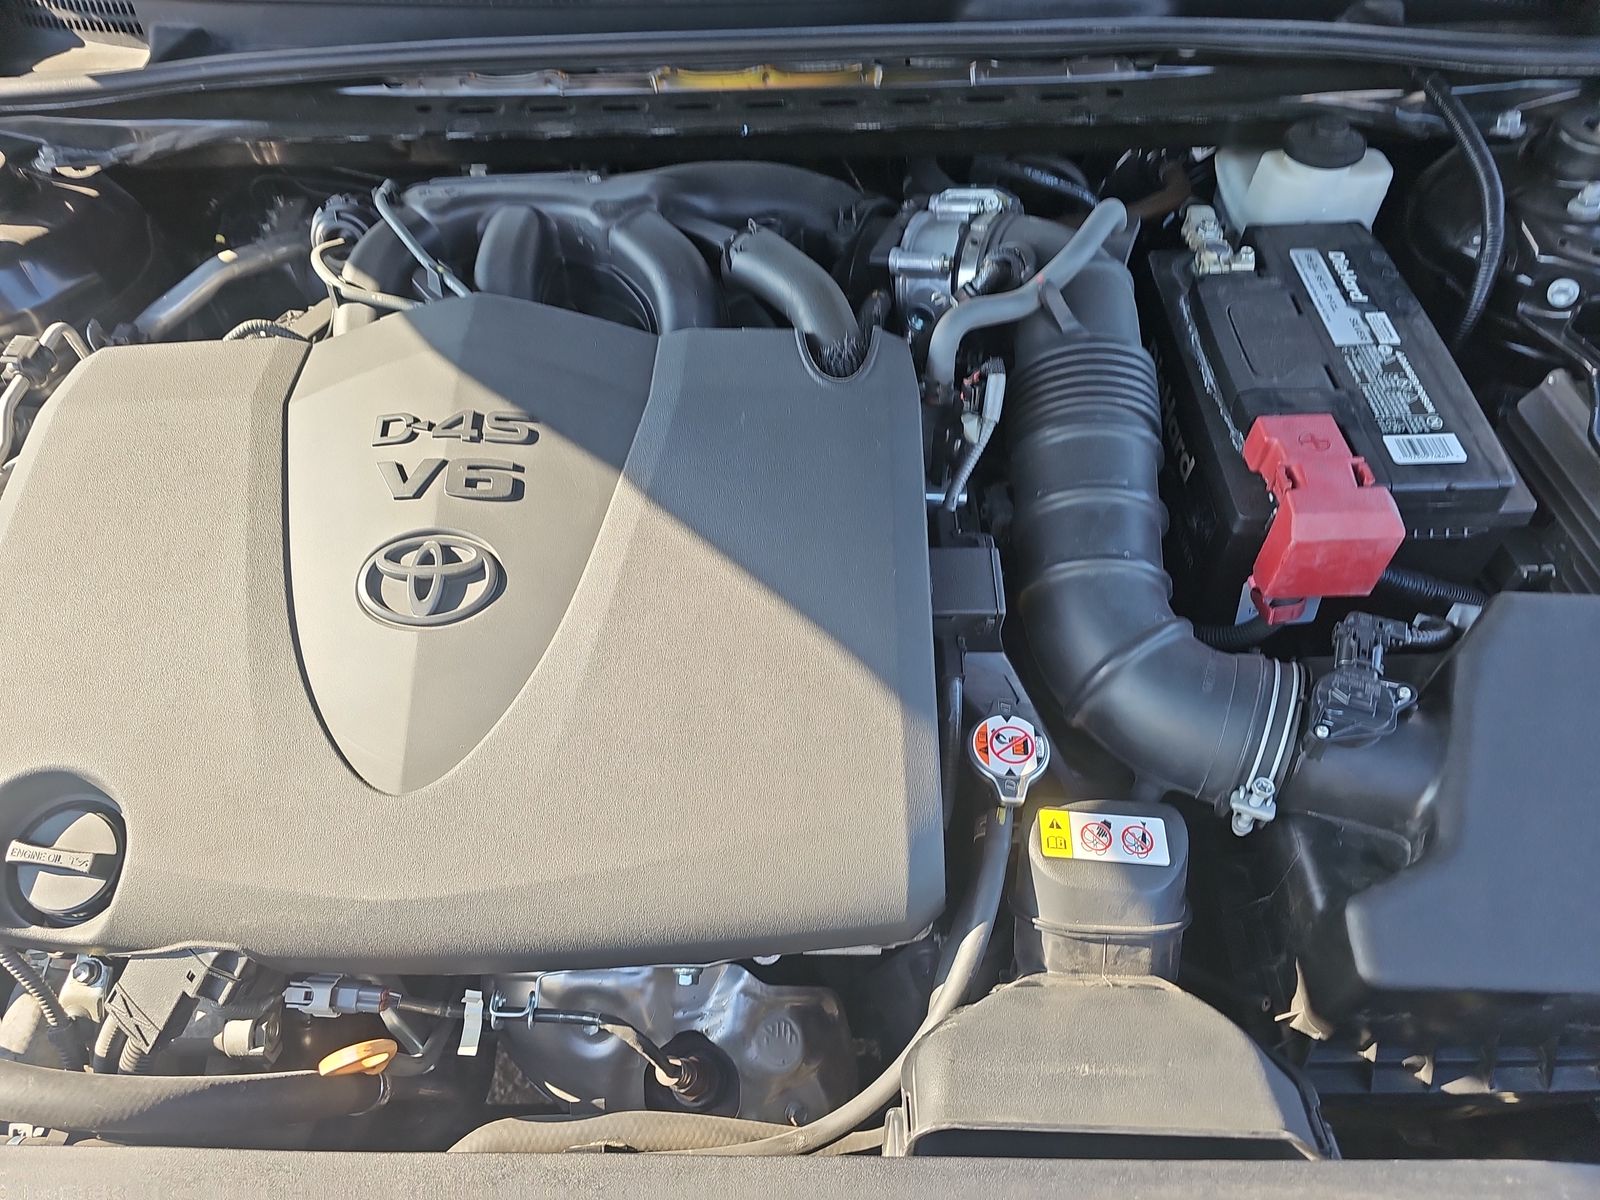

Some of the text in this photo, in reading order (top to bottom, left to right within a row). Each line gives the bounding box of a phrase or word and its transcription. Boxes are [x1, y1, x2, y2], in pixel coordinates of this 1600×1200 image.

[1328, 250, 1369, 303] DieHard
[376, 457, 526, 502] V6
[10, 847, 63, 865] ENGINE OIL
